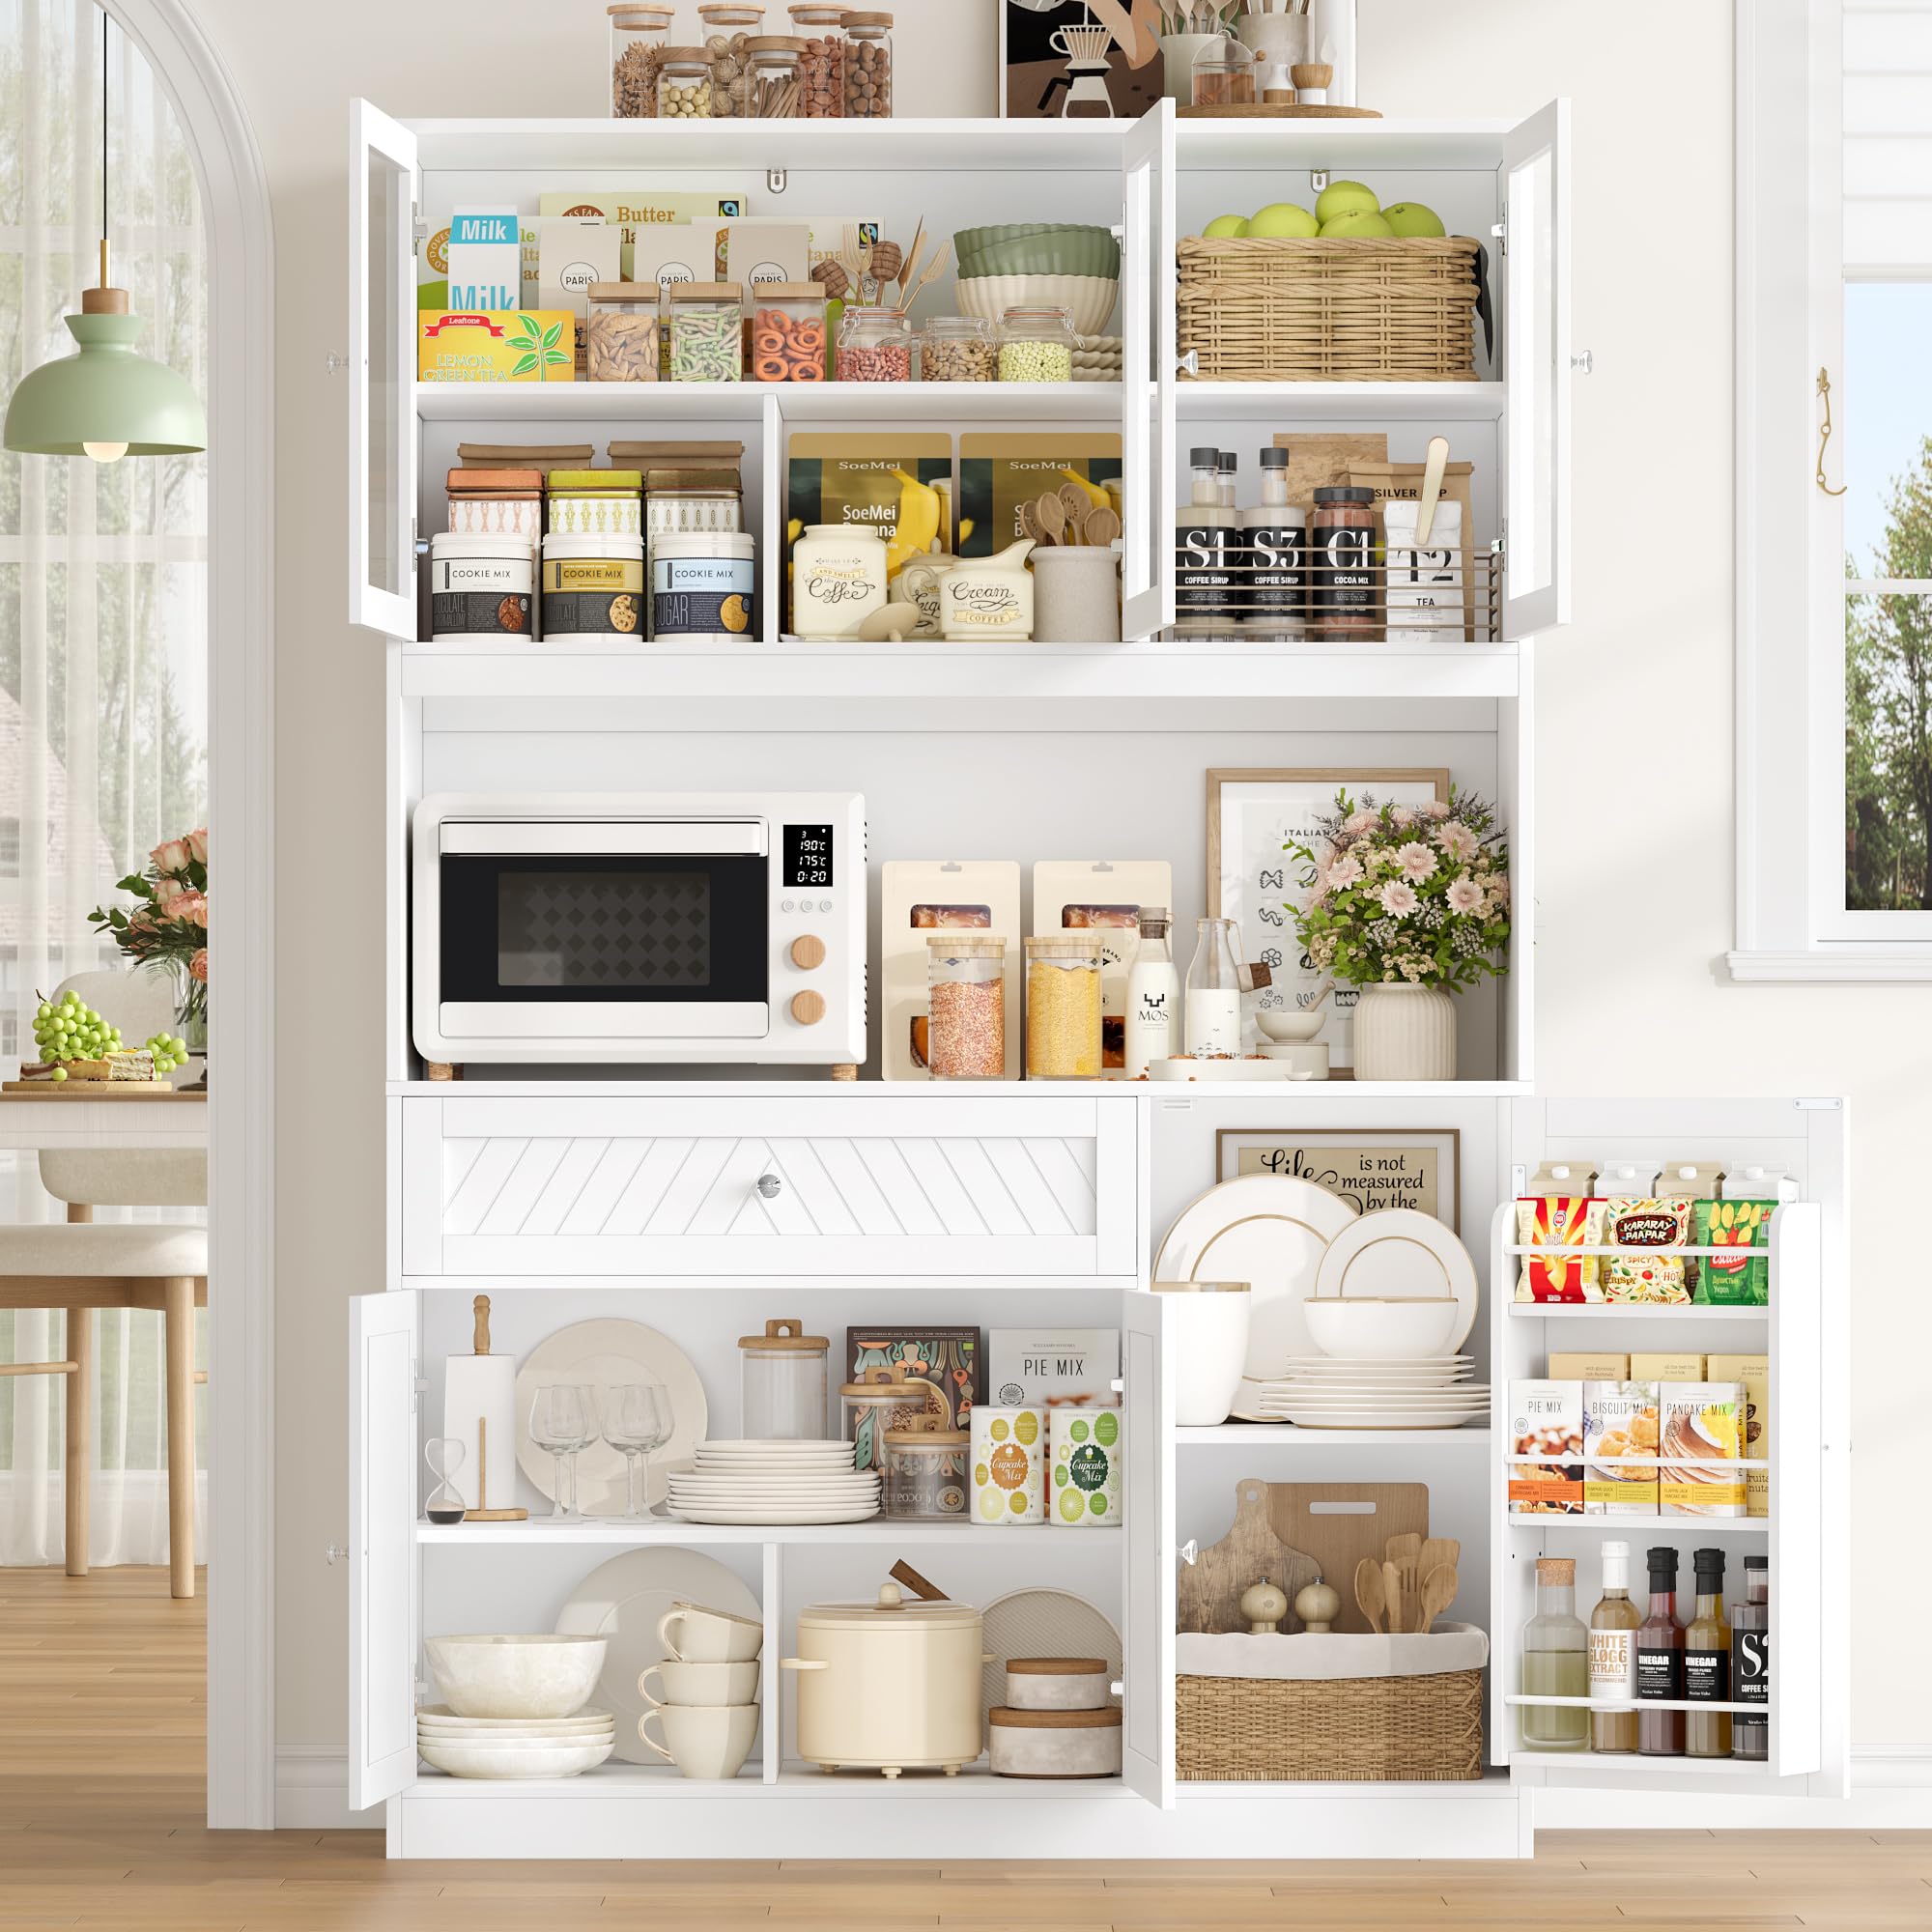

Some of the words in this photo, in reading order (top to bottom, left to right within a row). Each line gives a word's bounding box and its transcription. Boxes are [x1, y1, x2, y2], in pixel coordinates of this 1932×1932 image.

[616, 206, 675, 223] Butter
[461, 219, 507, 241] Milk
[566, 276, 594, 285] PARIS
[451, 285, 515, 310] Milk
[437, 355, 494, 367] LEMON
[423, 369, 476, 382] GREEN
[478, 369, 508, 382] TEA
[838, 462, 900, 470] SoeMei
[1009, 462, 1071, 470] SoeMei
[1375, 489, 1417, 497] SILVER
[842, 505, 895, 521] SoeMei
[1184, 530, 1225, 568] S1
[1327, 530, 1369, 568] C1
[806, 577, 875, 604] Coffee
[949, 582, 1016, 605] Cream
[1416, 598, 1435, 607] TEA
[969, 614, 1006, 623] COFFEE
[797, 870, 827, 882] 0:20
[1359, 1154, 1373, 1171] is
[1378, 1154, 1406, 1171] not
[1341, 1169, 1425, 1189] measured
[1391, 1190, 1418, 1209] the
[1623, 1220, 1673, 1232] KARARAY
[1625, 1231, 1667, 1240] PAAPAR
[1663, 1271, 1680, 1282] HOT
[1024, 1359, 1048, 1377] PIE
[1057, 1359, 1084, 1377] MIX
[1528, 1401, 1542, 1413] PIE
[1546, 1401, 1562, 1413] MIX
[1592, 1402, 1628, 1415] BISCUIT
[1633, 1402, 1648, 1415] MIX
[1666, 1404, 1707, 1416] PANCAKE
[1711, 1404, 1727, 1416] MIX
[992, 1458, 1026, 1471] Cupcake
[1072, 1459, 1106, 1472] Cupcake
[1003, 1468, 1023, 1481] Mix
[1083, 1469, 1102, 1482] Mix
[1591, 1634, 1628, 1649] WHITE
[1638, 1655, 1670, 1665] VINEGAR
[1685, 1657, 1718, 1667] VINEGAR
[1741, 1684, 1762, 1693] COFFEE
